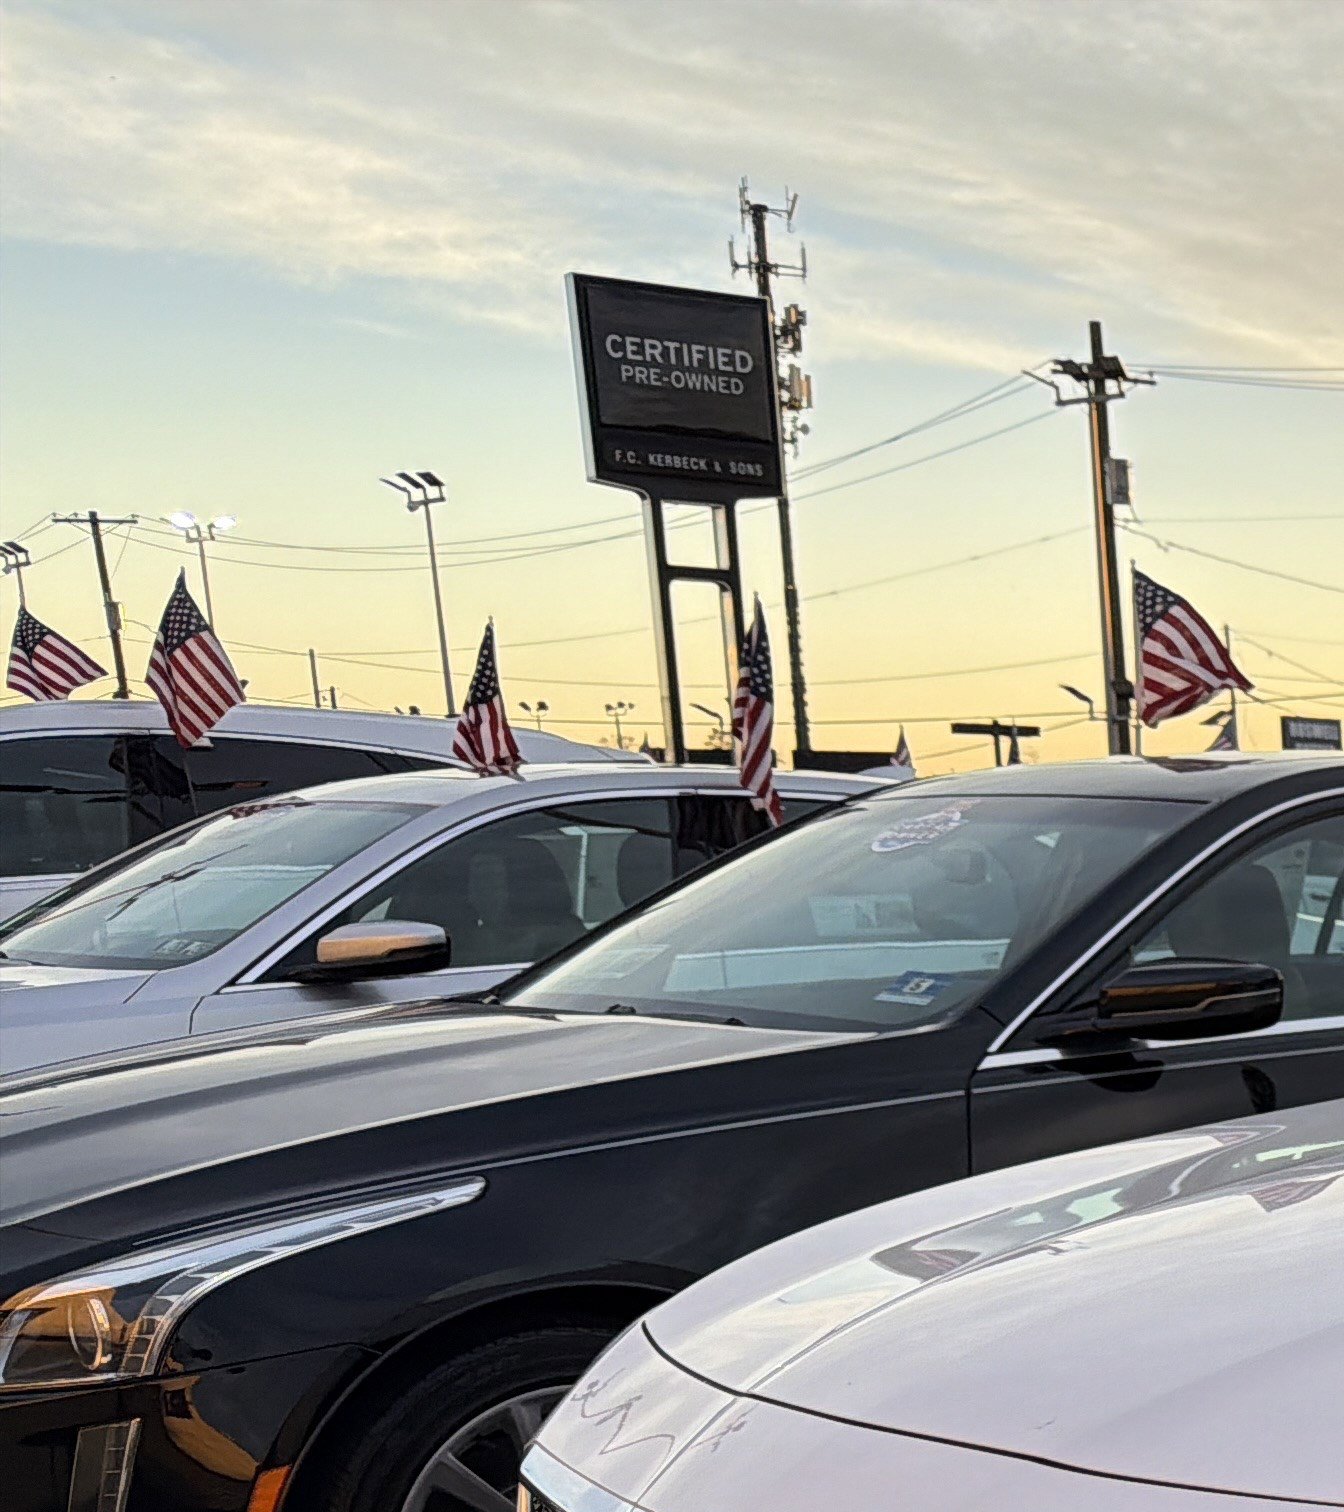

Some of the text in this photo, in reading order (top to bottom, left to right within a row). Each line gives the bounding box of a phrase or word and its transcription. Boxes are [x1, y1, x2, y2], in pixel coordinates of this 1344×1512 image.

[605, 334, 754, 375] CERTIFIED
[620, 364, 745, 396] PRE-OWNED
[615, 449, 642, 465] F.C.
[649, 452, 708, 472] KERBECK
[729, 461, 764, 477] SONS
